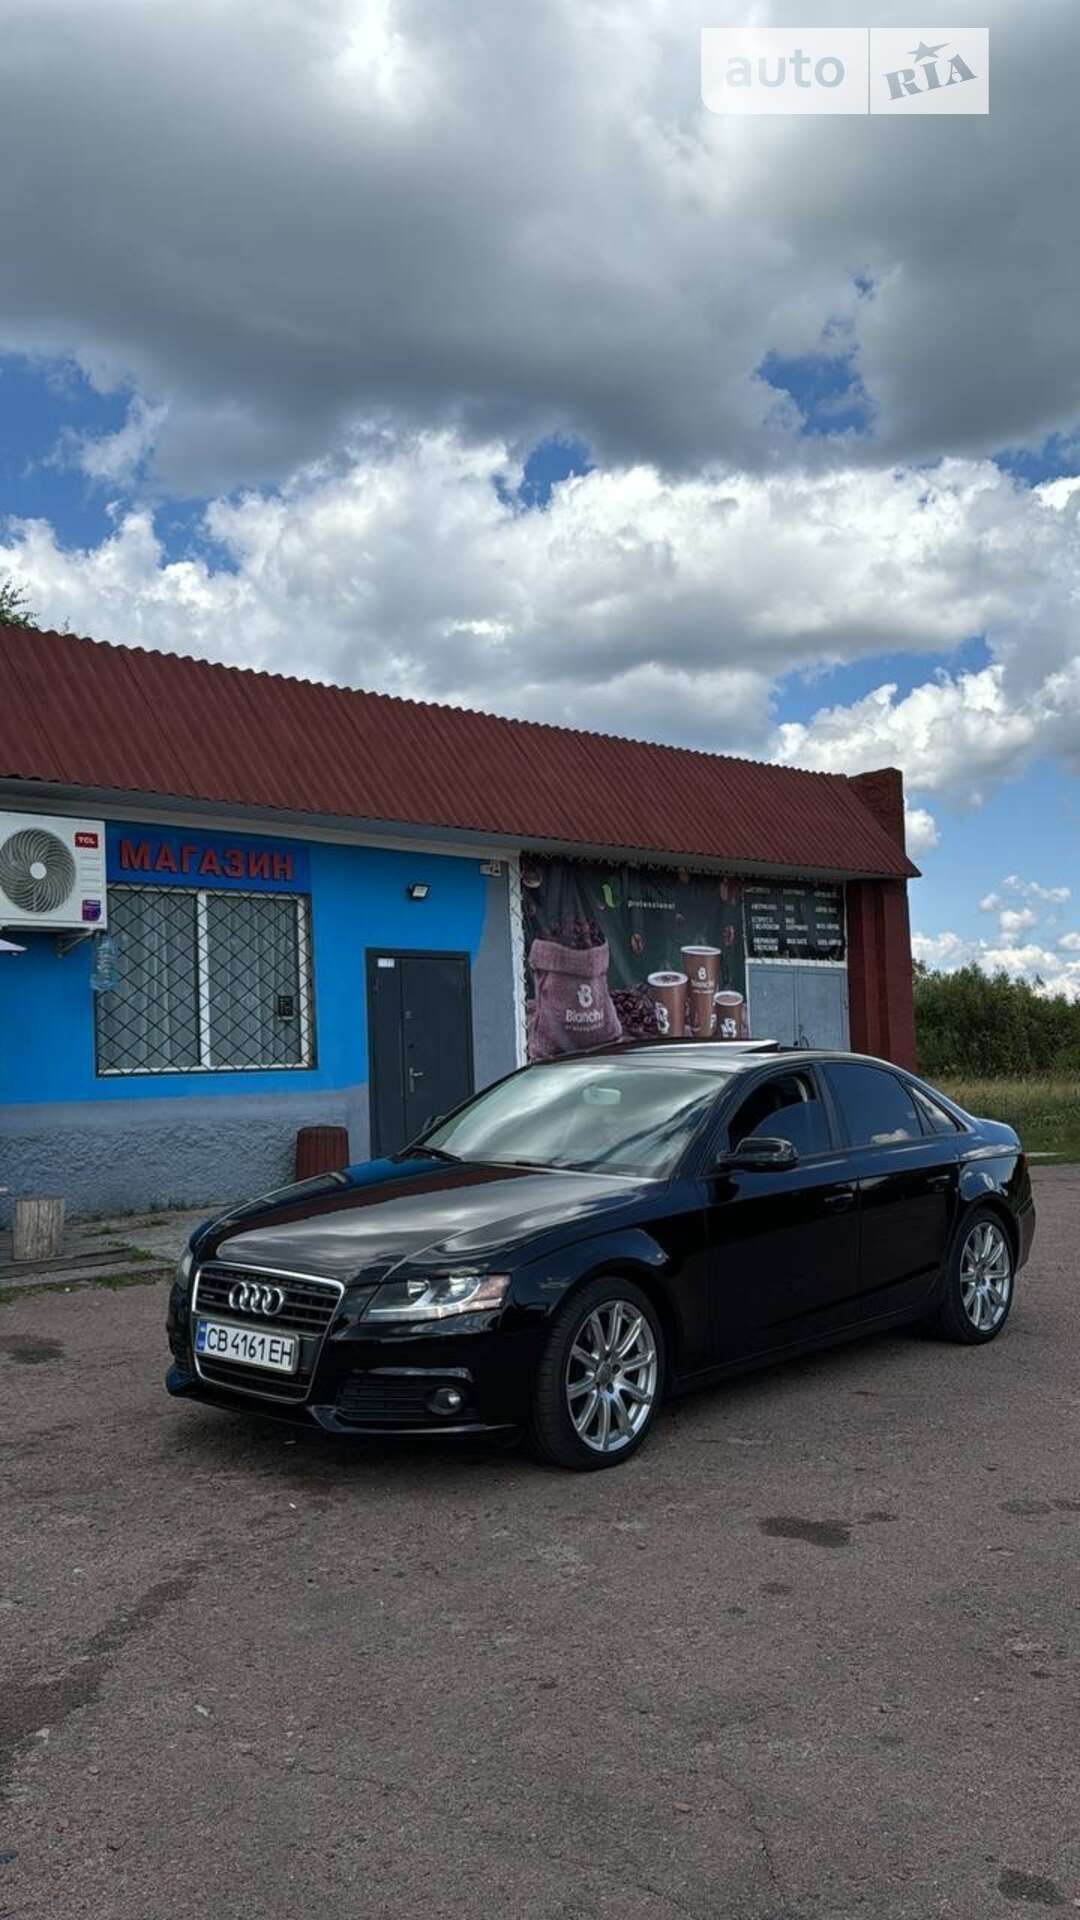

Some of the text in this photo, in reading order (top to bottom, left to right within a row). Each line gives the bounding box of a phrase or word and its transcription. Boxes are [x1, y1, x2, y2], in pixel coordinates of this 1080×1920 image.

[77, 836, 96, 845] TCL
[119, 839, 294, 881] МАГАЗИН
[566, 1008, 604, 1023] Bianchi
